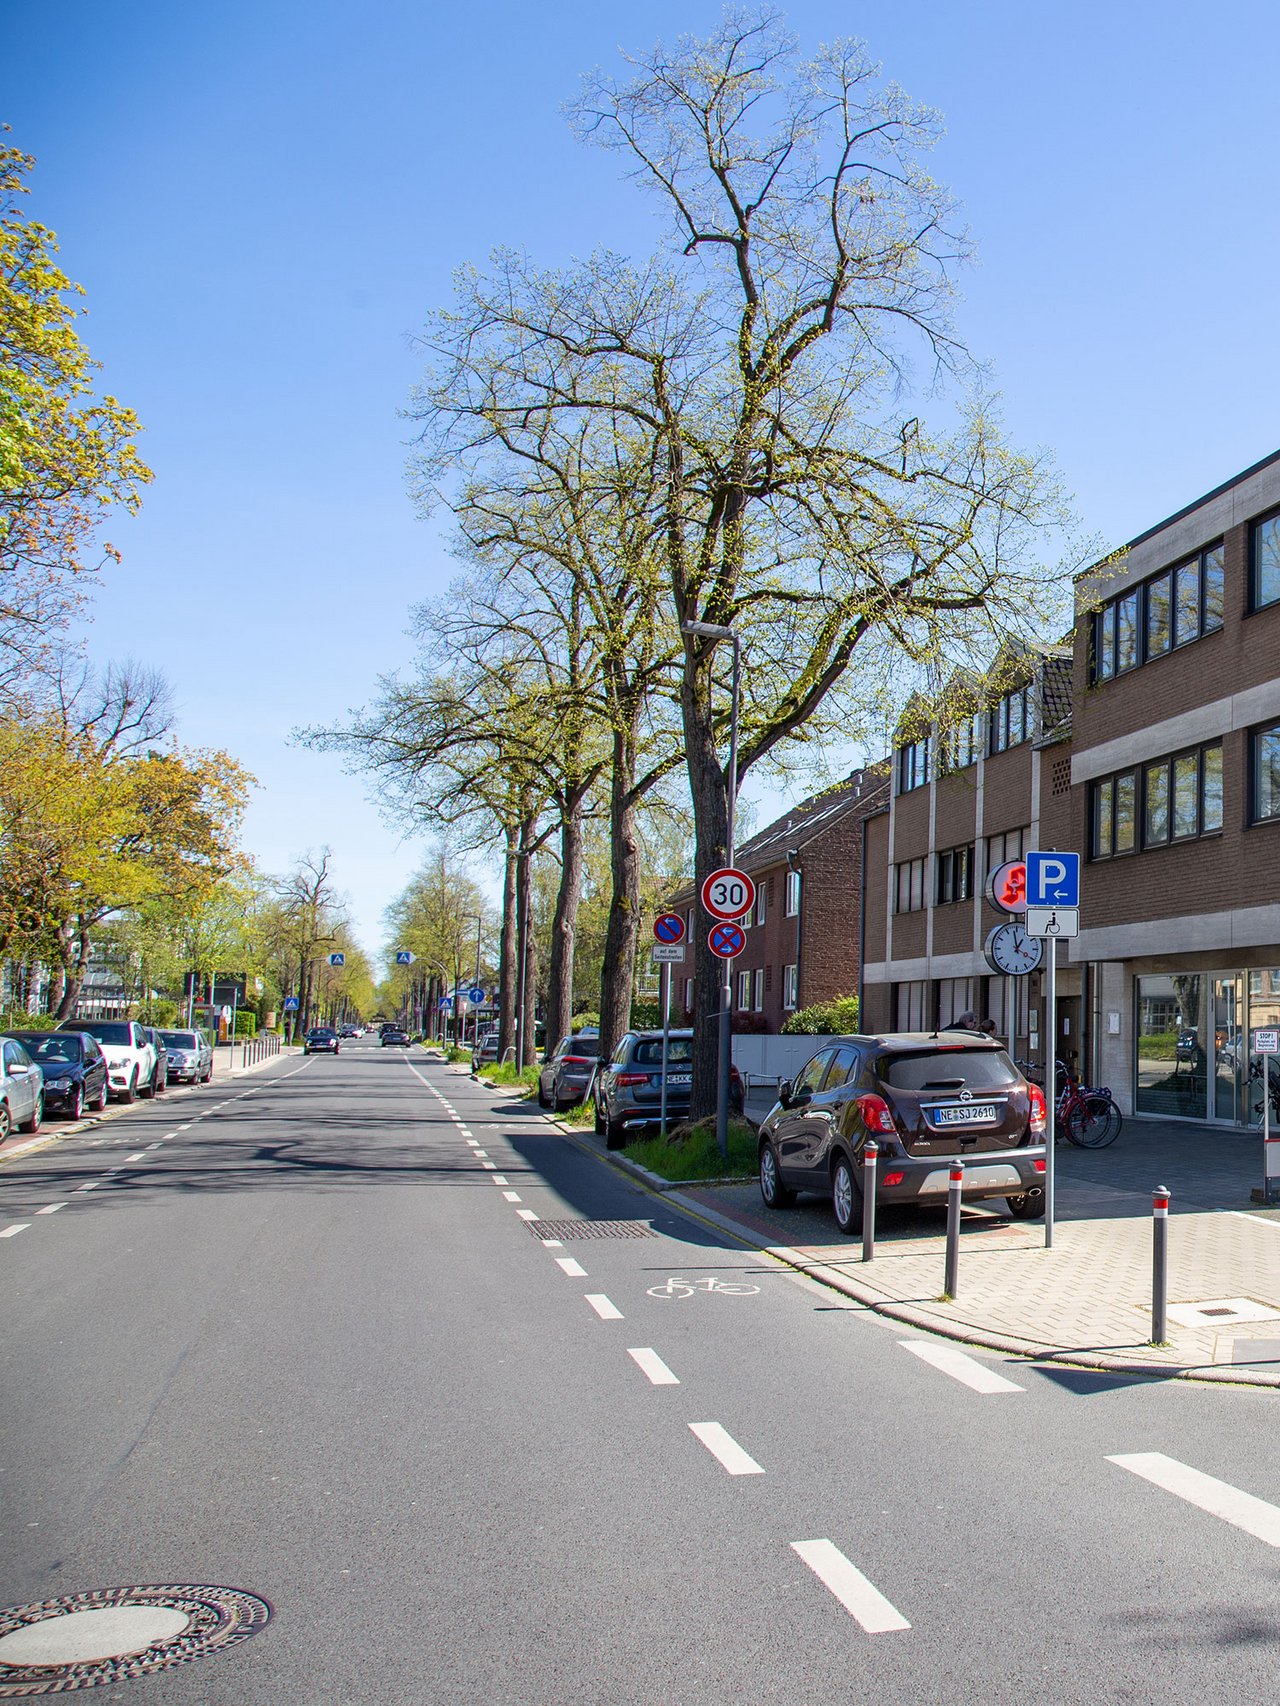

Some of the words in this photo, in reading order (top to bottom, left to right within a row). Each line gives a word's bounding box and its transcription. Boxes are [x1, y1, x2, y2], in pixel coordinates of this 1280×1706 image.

[1039, 859, 1067, 899] P
[713, 883, 743, 906] 30
[940, 1109, 953, 1121] NE
[959, 1108, 971, 1120] SJ
[972, 1106, 994, 1119] 2610
